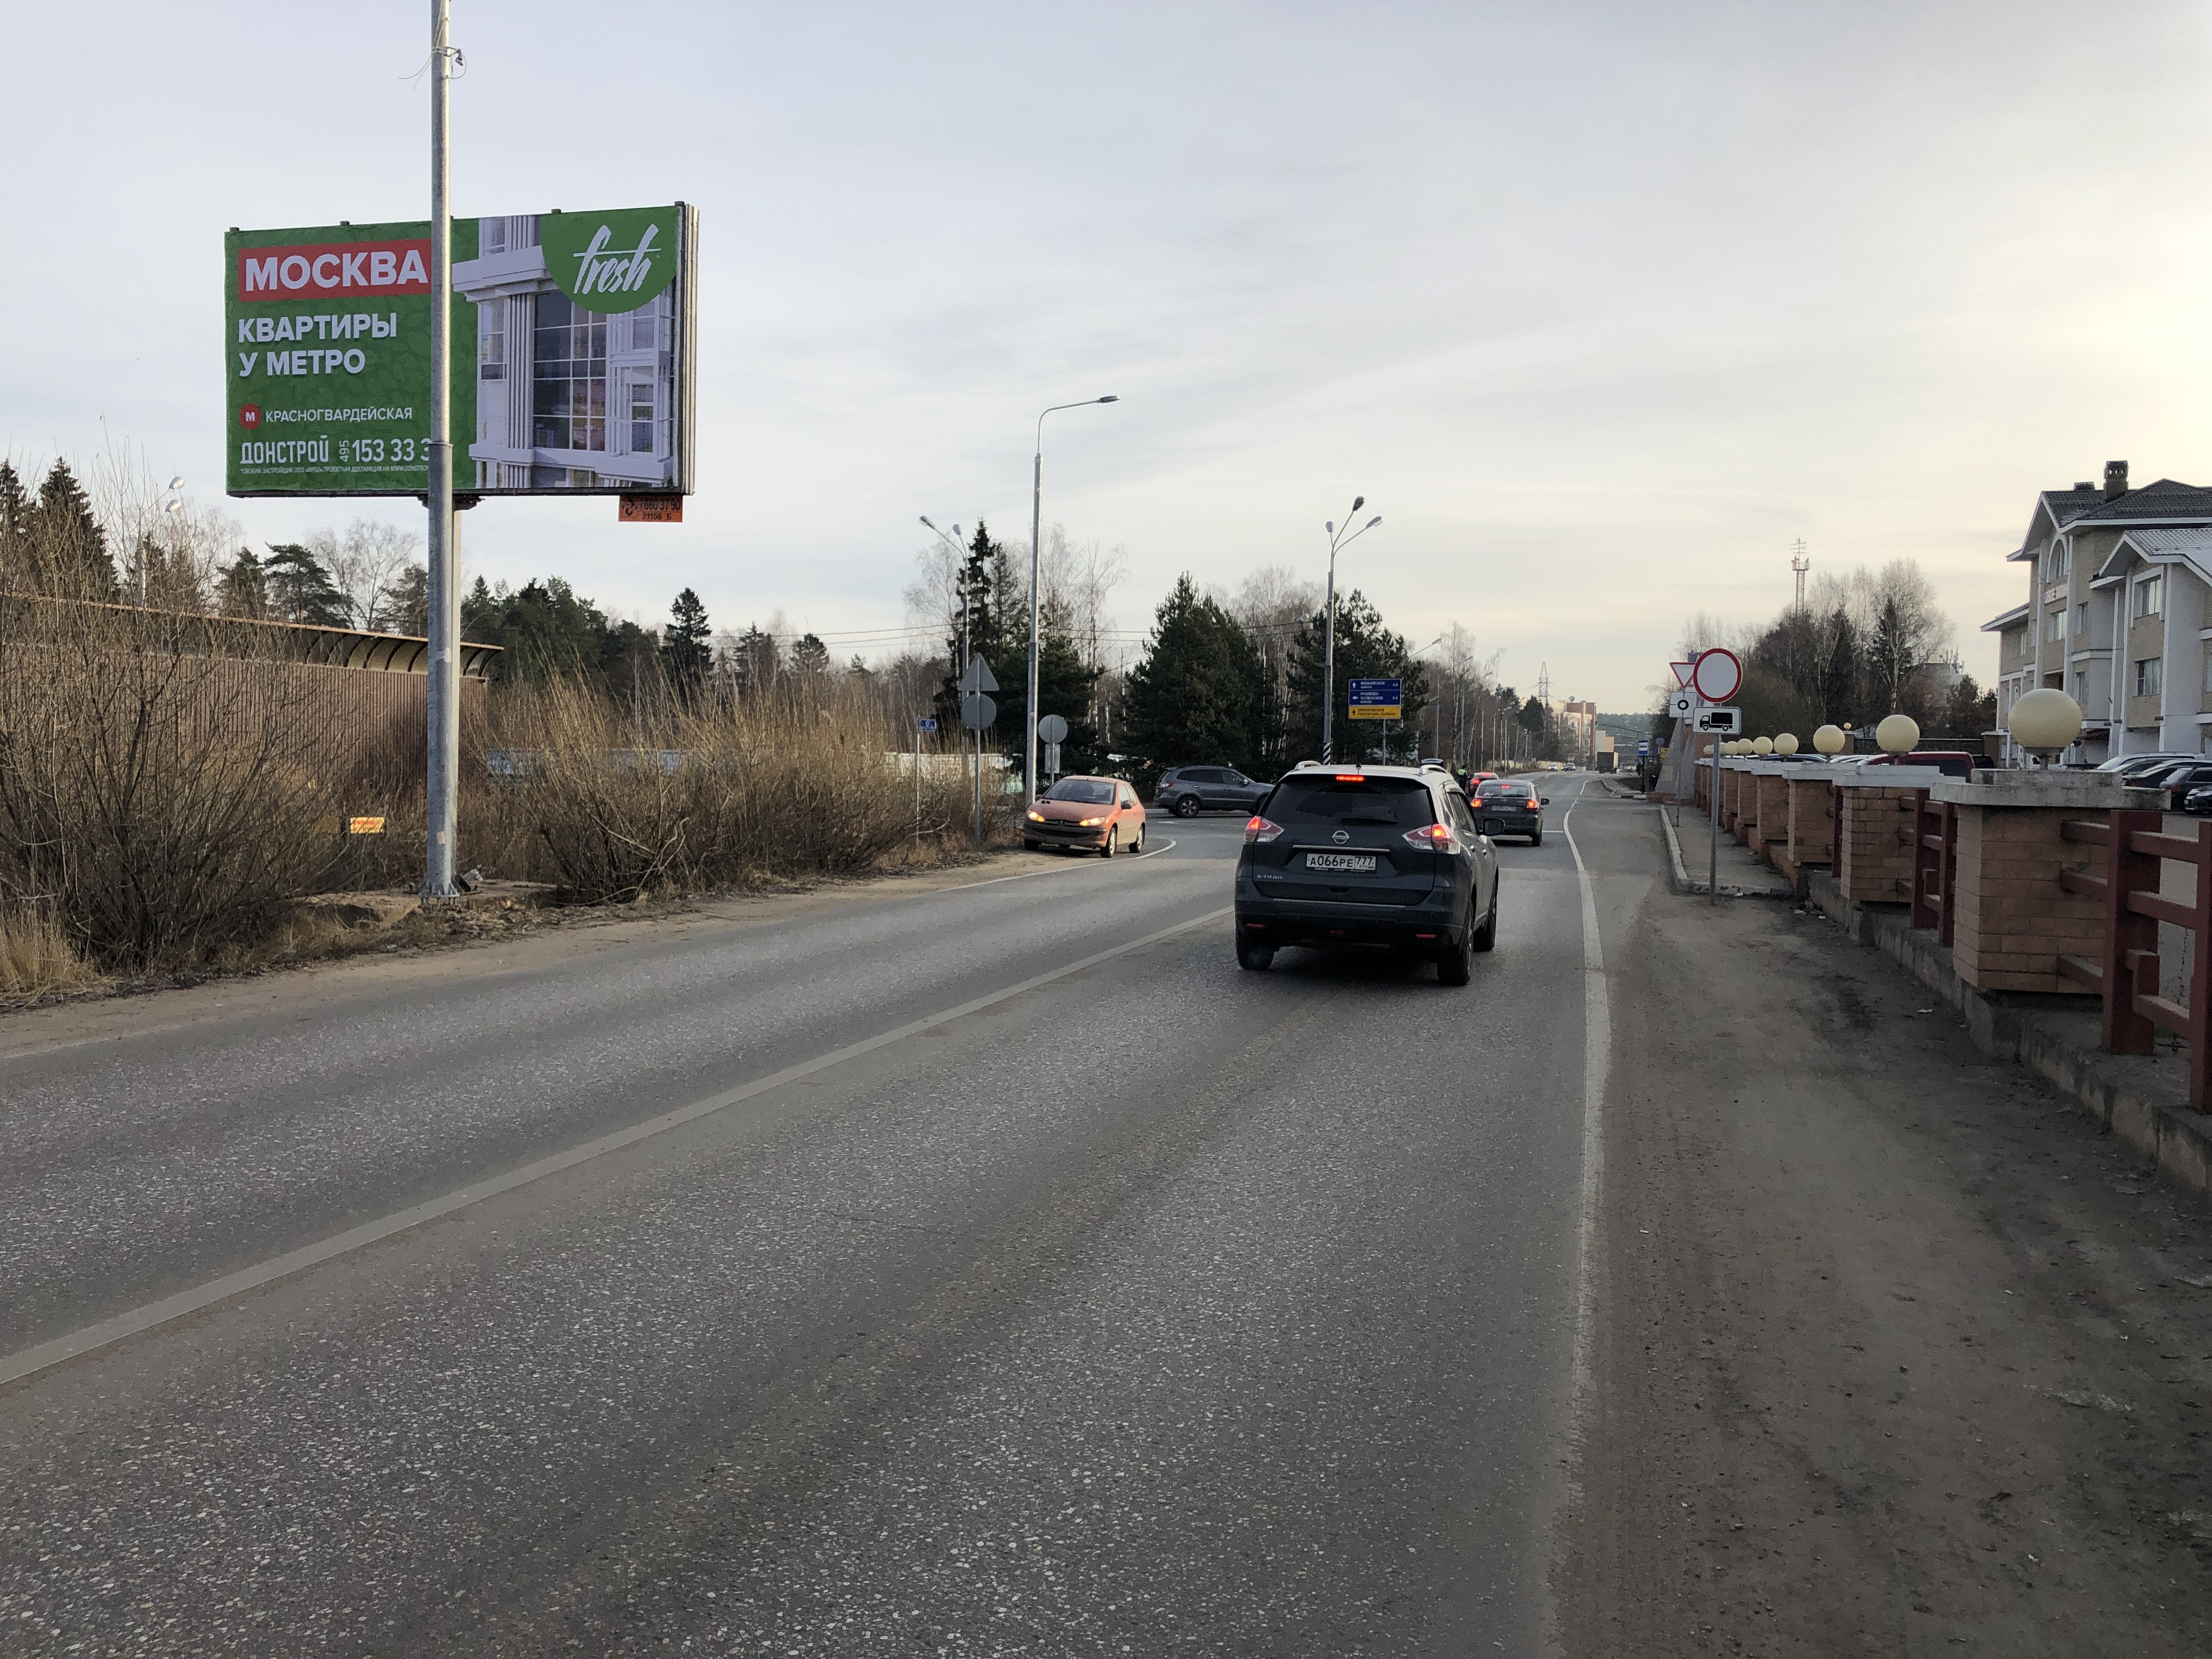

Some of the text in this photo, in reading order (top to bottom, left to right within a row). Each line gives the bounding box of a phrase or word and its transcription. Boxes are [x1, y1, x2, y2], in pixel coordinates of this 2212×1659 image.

[246, 249, 428, 292] МОСКВА
[573, 224, 661, 295] fresh
[238, 312, 397, 343] КВАРТИРЫ
[239, 348, 365, 377] У МЕТРО
[266, 405, 413, 422] КРАСНОГВАРДЕЙСКАЯ
[240, 435, 329, 464] ДОНСТРОЙ
[338, 440, 349, 462] 495
[352, 439, 384, 462] 153
[391, 438, 414, 462] 33
[1356, 856, 1373, 865] 777
